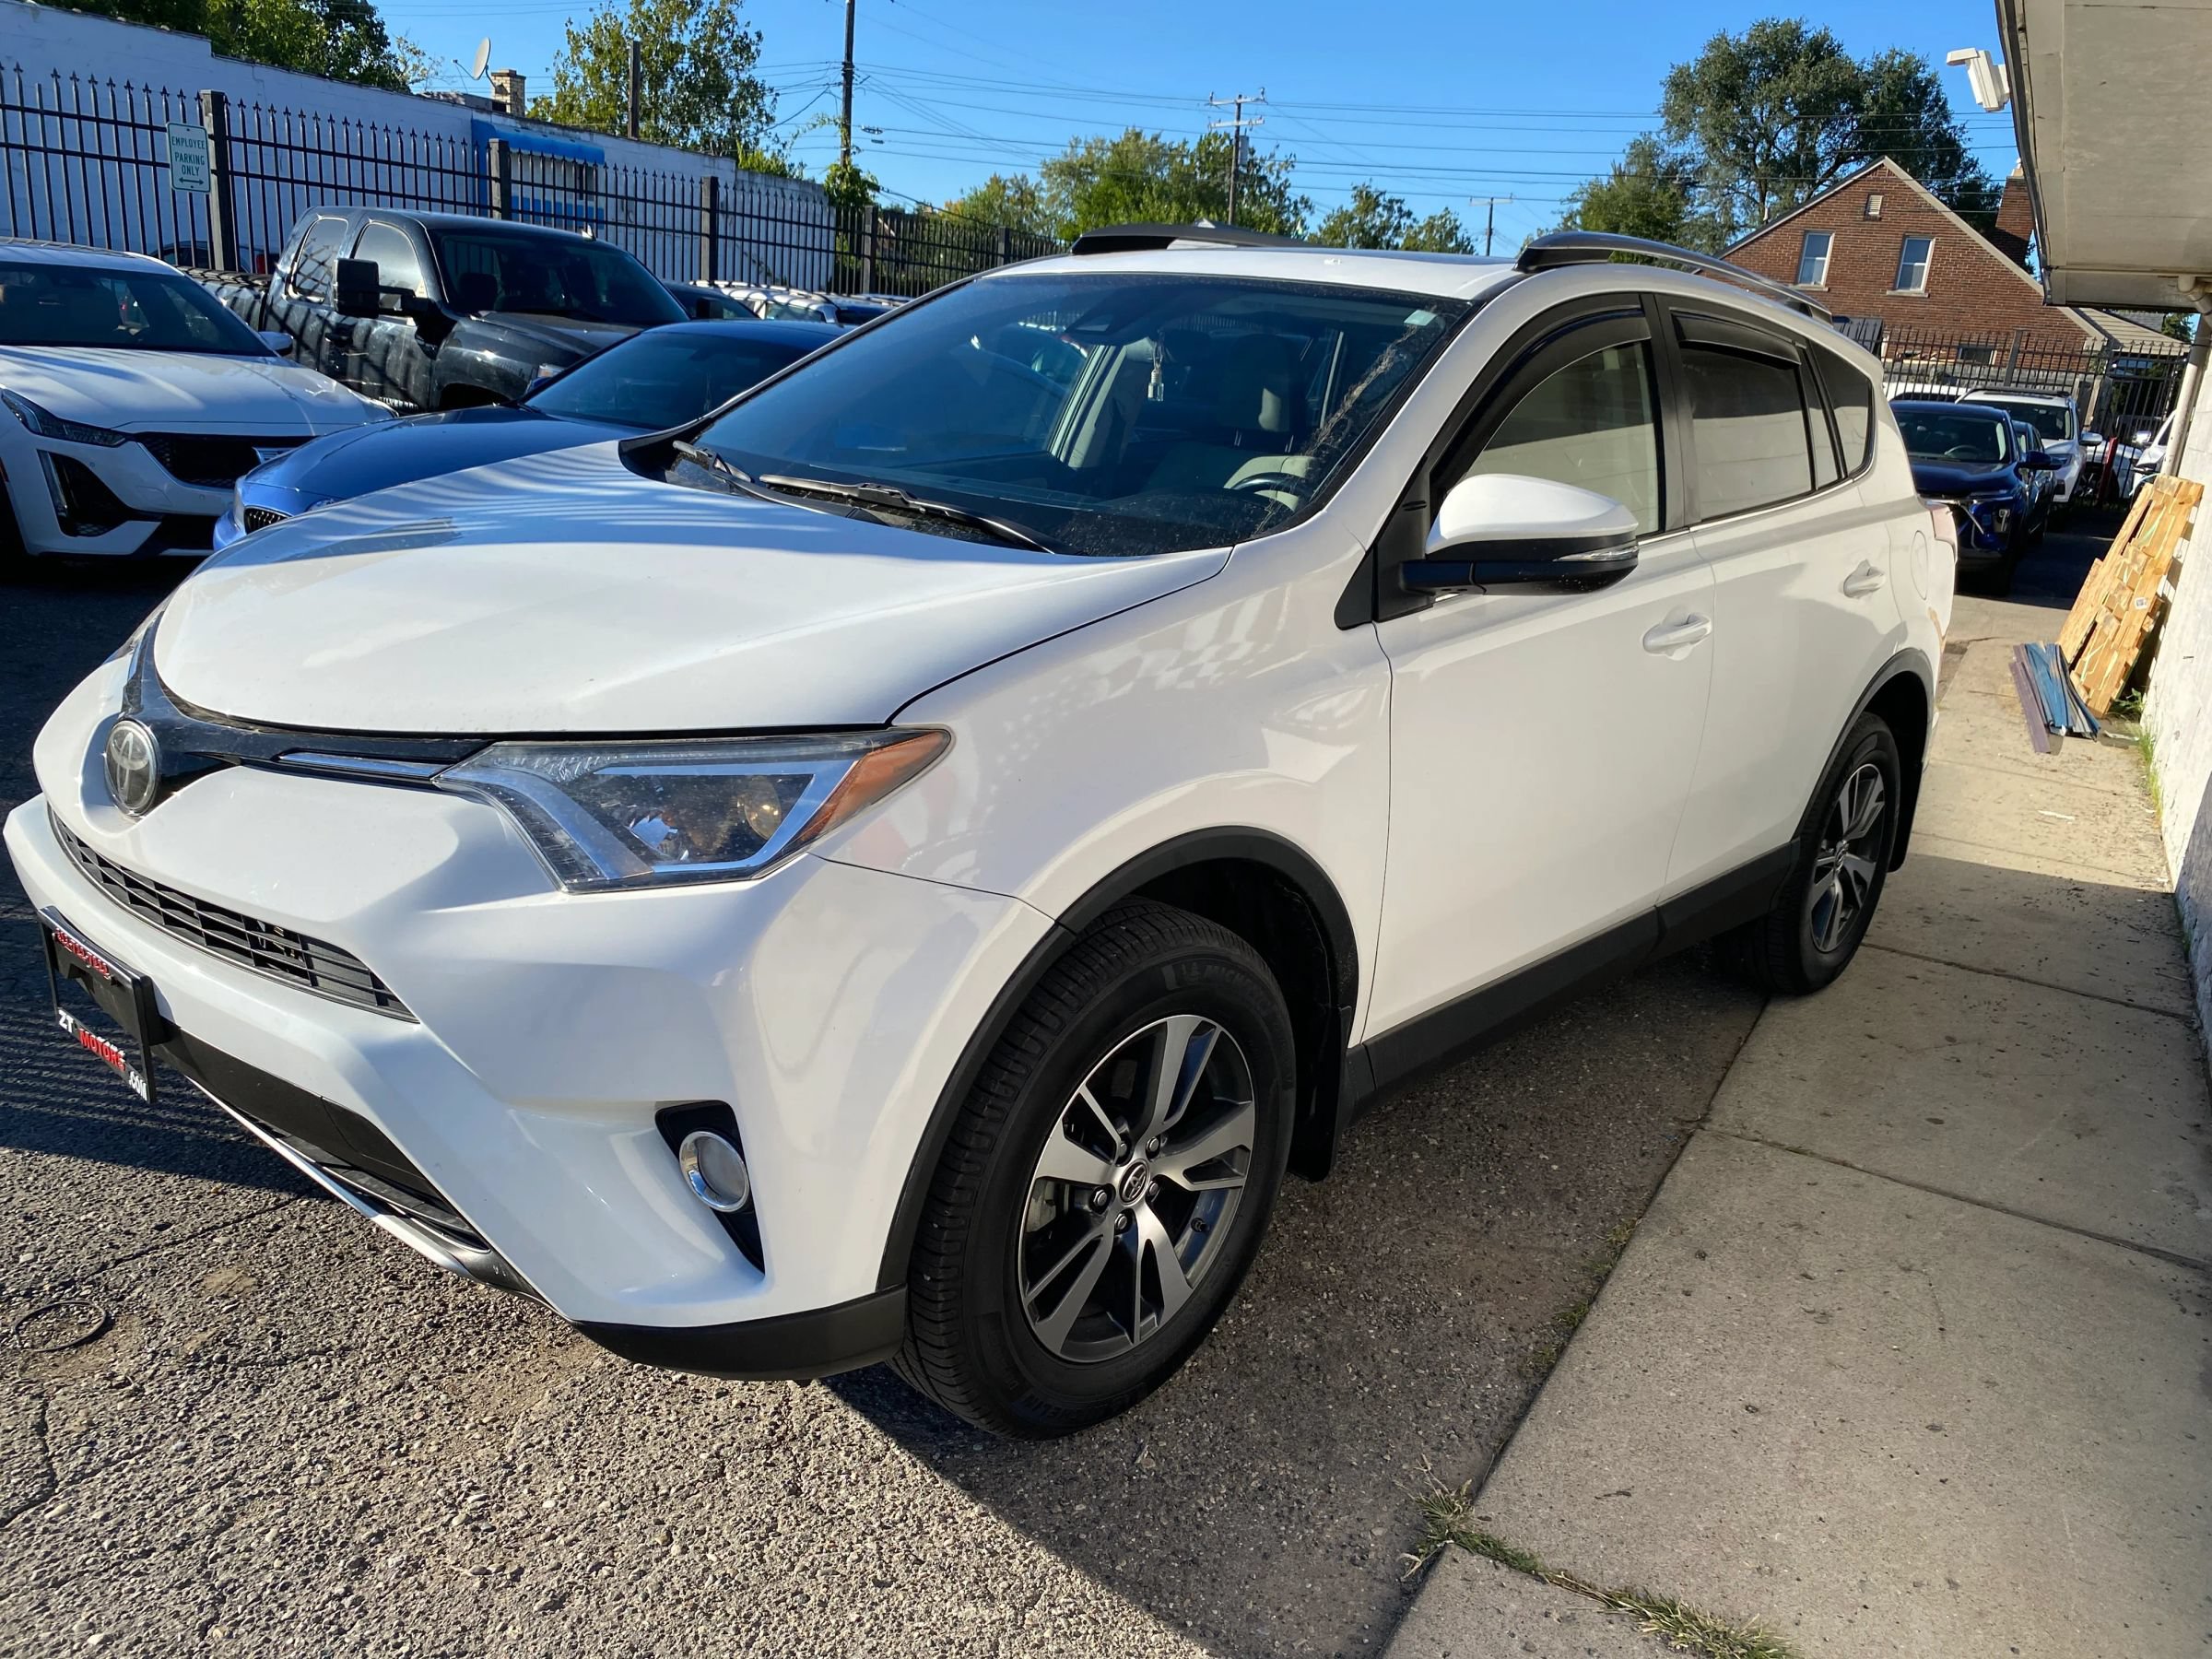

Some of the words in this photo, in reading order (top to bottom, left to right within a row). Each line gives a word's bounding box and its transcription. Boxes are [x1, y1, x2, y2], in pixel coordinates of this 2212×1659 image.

[171, 136, 206, 149] EMPLOYEE
[175, 152, 205, 165] PARKING
[182, 165, 200, 176] ONLY
[58, 1009, 74, 1033] ZT
[78, 1028, 126, 1072] MOTORS
